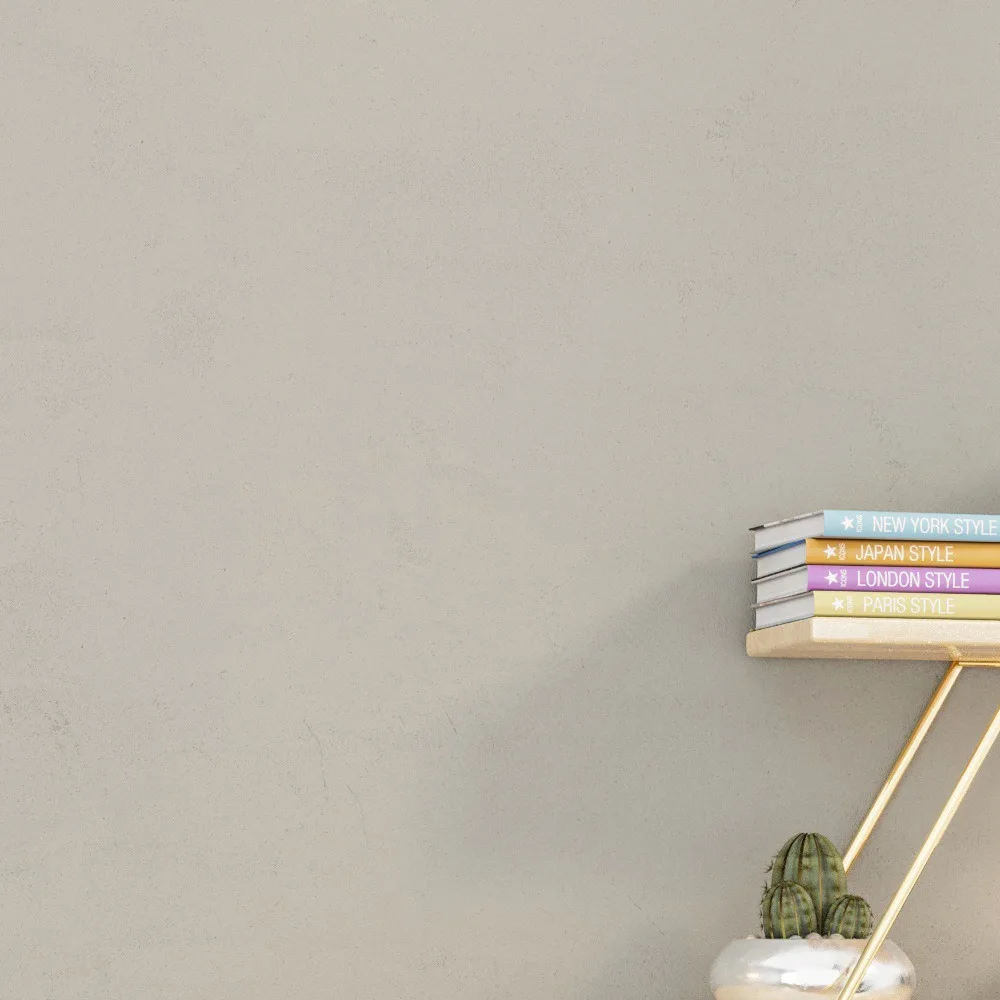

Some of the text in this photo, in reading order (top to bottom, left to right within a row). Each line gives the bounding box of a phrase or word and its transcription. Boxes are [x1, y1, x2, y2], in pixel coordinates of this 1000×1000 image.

[855, 513, 863, 533] ICONS
[872, 515, 998, 536] NEW YORK STYLE
[838, 542, 846, 561] ICONS
[855, 544, 954, 563] JAPAN STYLE
[840, 568, 848, 588] ICONS
[857, 570, 970, 589] LONDON STYLE
[863, 596, 955, 615] PARIS STYLE
